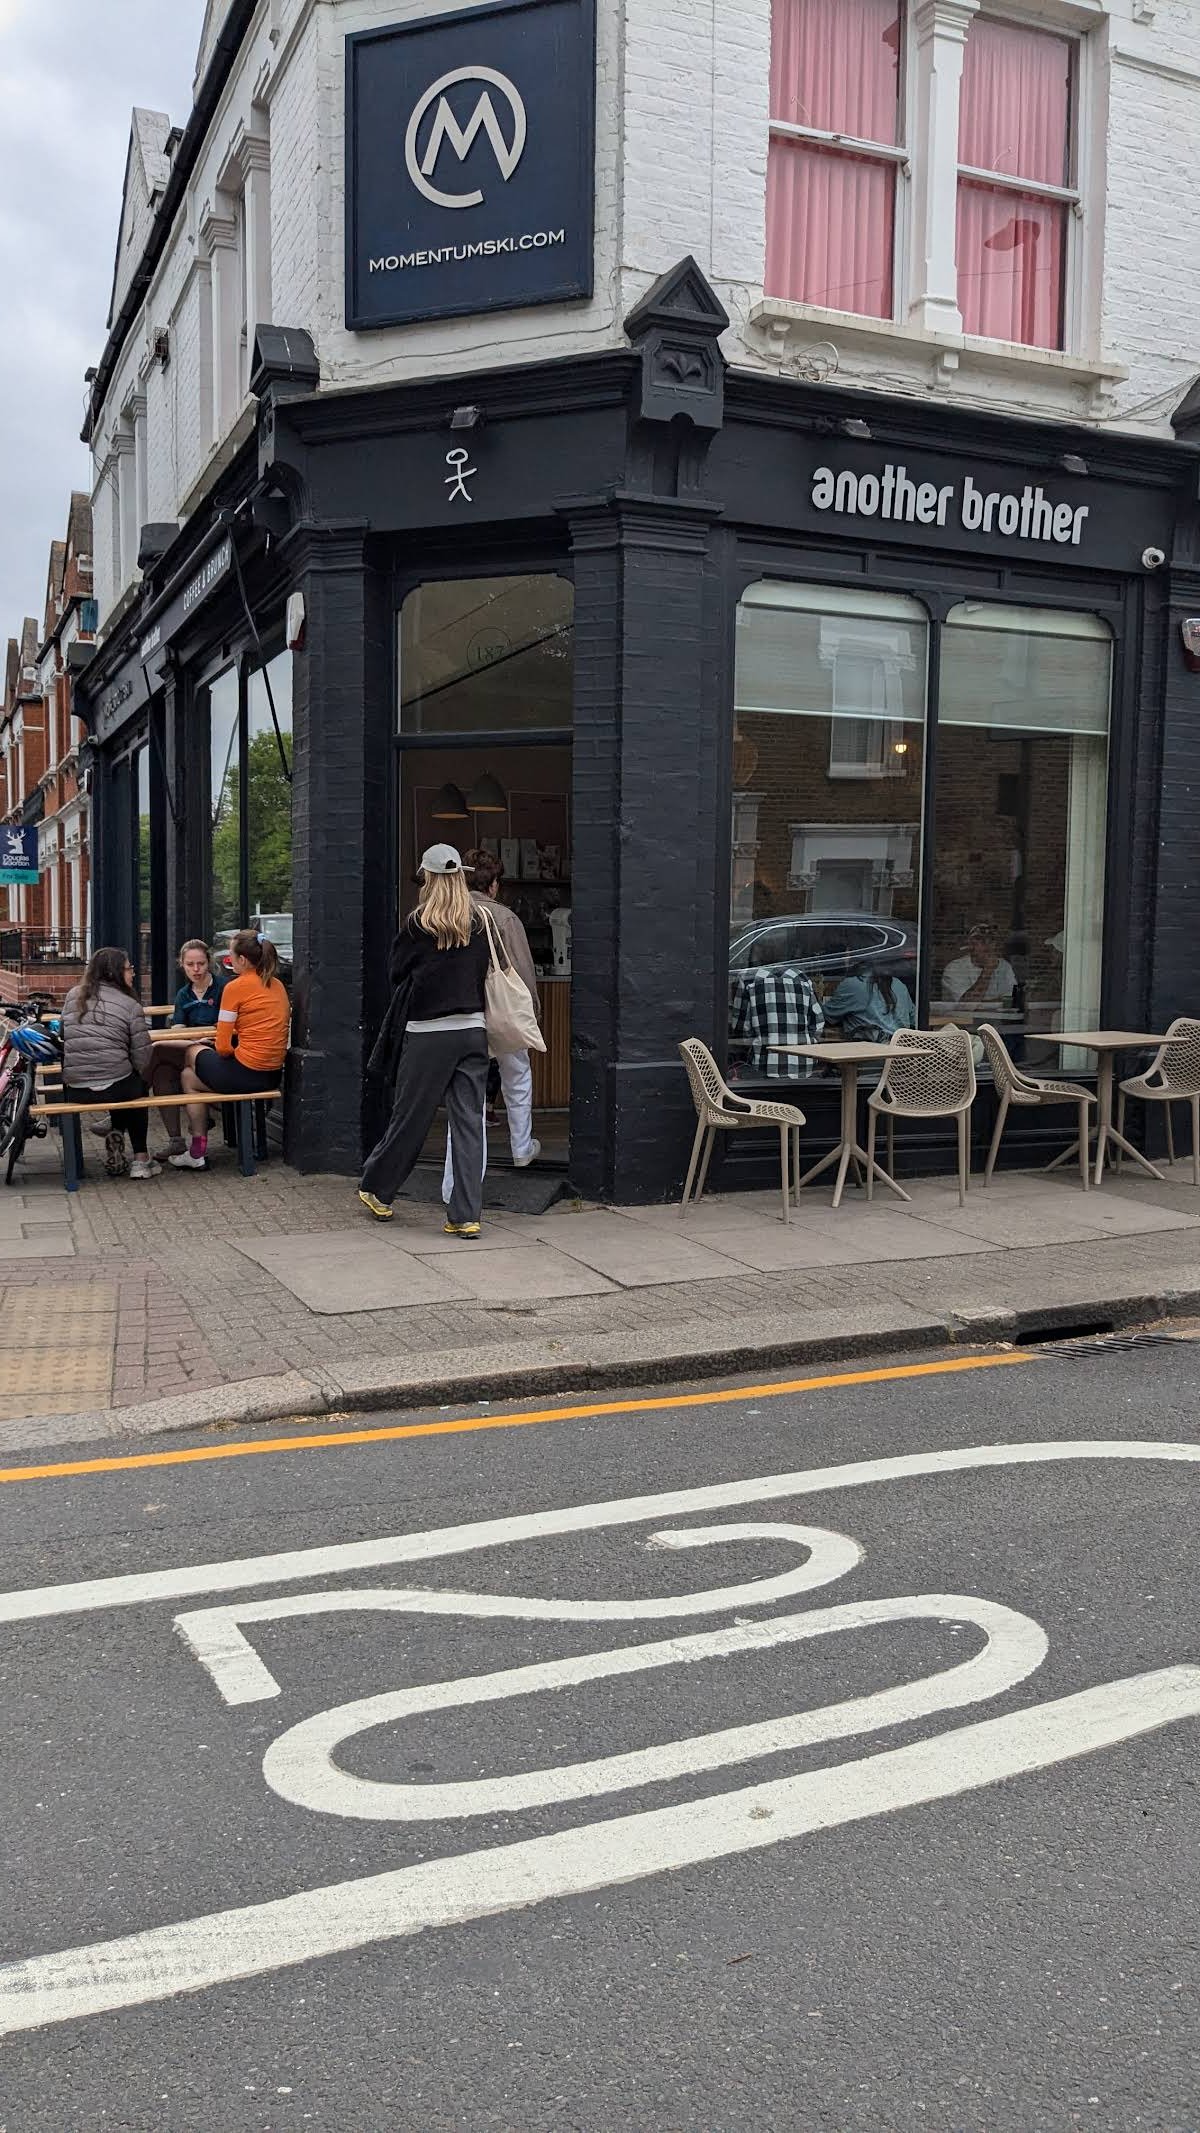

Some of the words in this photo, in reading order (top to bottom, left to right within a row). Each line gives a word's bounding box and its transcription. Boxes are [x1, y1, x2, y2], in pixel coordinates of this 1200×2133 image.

[368, 228, 566, 273] MOMENTUMSKI.COM
[811, 464, 954, 526] another
[961, 476, 1089, 545] brother
[183, 575, 202, 611] COFFEE
[207, 545, 230, 584] BRUNCH
[3, 854, 30, 862] Douglas
